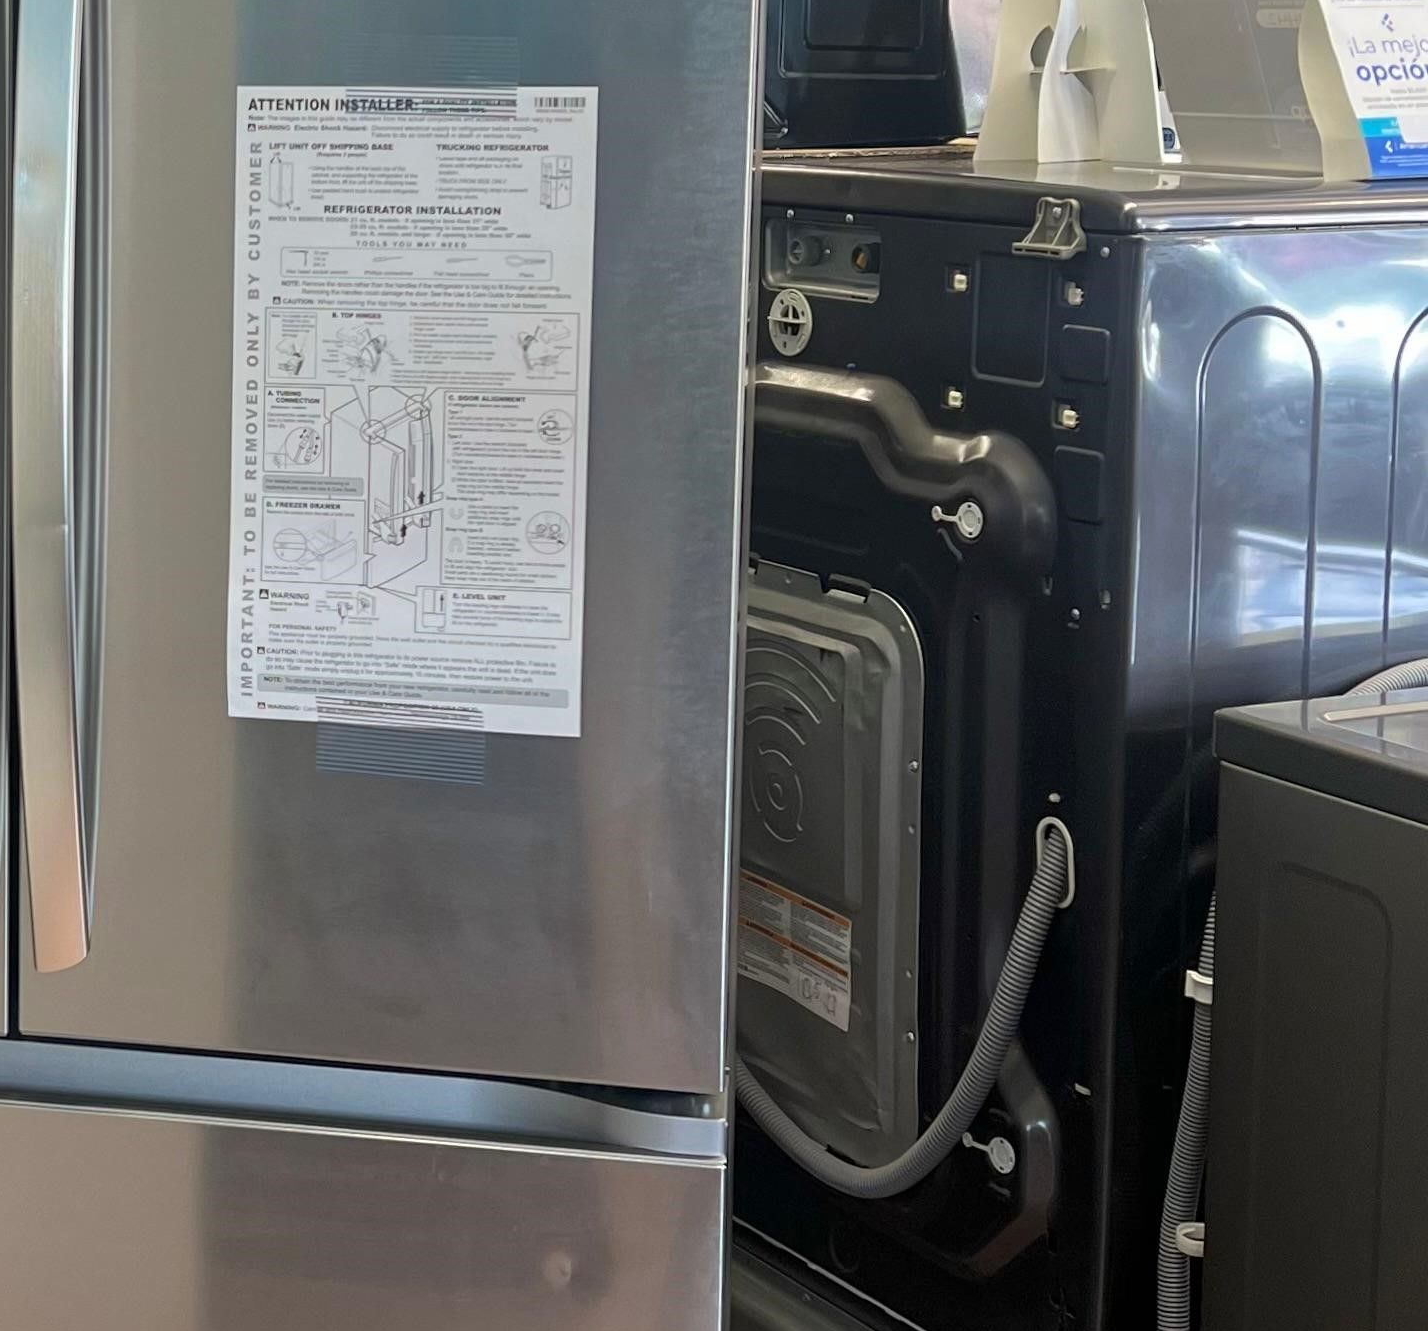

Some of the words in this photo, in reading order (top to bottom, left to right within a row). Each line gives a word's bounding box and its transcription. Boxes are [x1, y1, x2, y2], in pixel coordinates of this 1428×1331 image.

[1348, 36, 1377, 58] ¡La
[1381, 34, 1428, 57] mejo
[1356, 57, 1428, 86] opció
[248, 99, 329, 111] ATTENTION
[483, 144, 549, 152] REFRIGERATOR
[248, 142, 262, 260] CUSTOMER
[324, 205, 413, 215] REFRIGERATOR
[416, 206, 501, 216] INSTALLATION
[247, 274, 260, 300] BY
[246, 312, 259, 367] ONLY
[245, 380, 258, 480] REMOVED
[244, 493, 256, 517] BE
[244, 530, 256, 556] TO
[270, 592, 309, 600] WARNING
